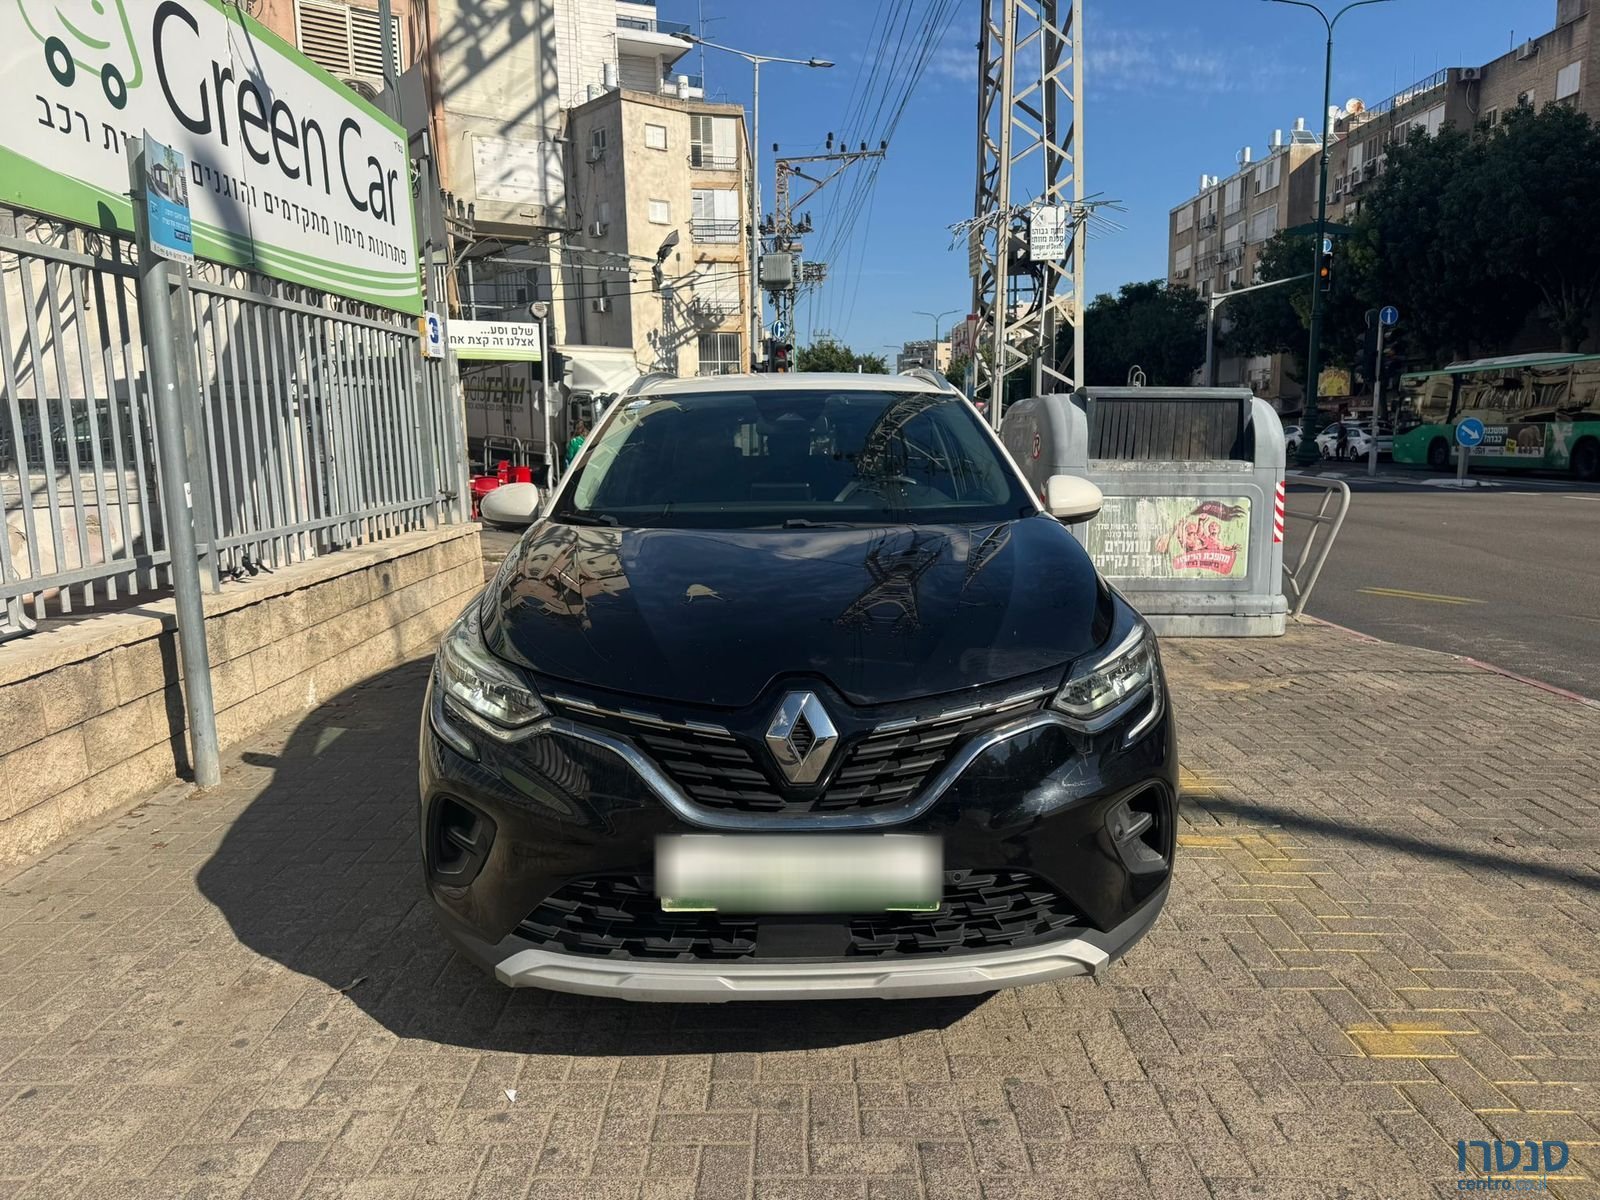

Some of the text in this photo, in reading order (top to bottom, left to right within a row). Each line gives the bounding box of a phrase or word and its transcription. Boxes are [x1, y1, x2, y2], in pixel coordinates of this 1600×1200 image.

[36, 94, 91, 143] רכב
[152, 0, 399, 227] Green Car
[191, 160, 257, 208] והוגנים
[264, 191, 331, 234] מתקדמים
[333, 220, 365, 245] מימון
[369, 235, 407, 265] פתרונות
[429, 317, 439, 343] 3
[450, 336, 534, 347] אצלנו זה קצת אח
[480, 326, 534, 336] שלם וסע...
[463, 376, 525, 404] OGISTEAM
[1105, 540, 1151, 553] שומרים
